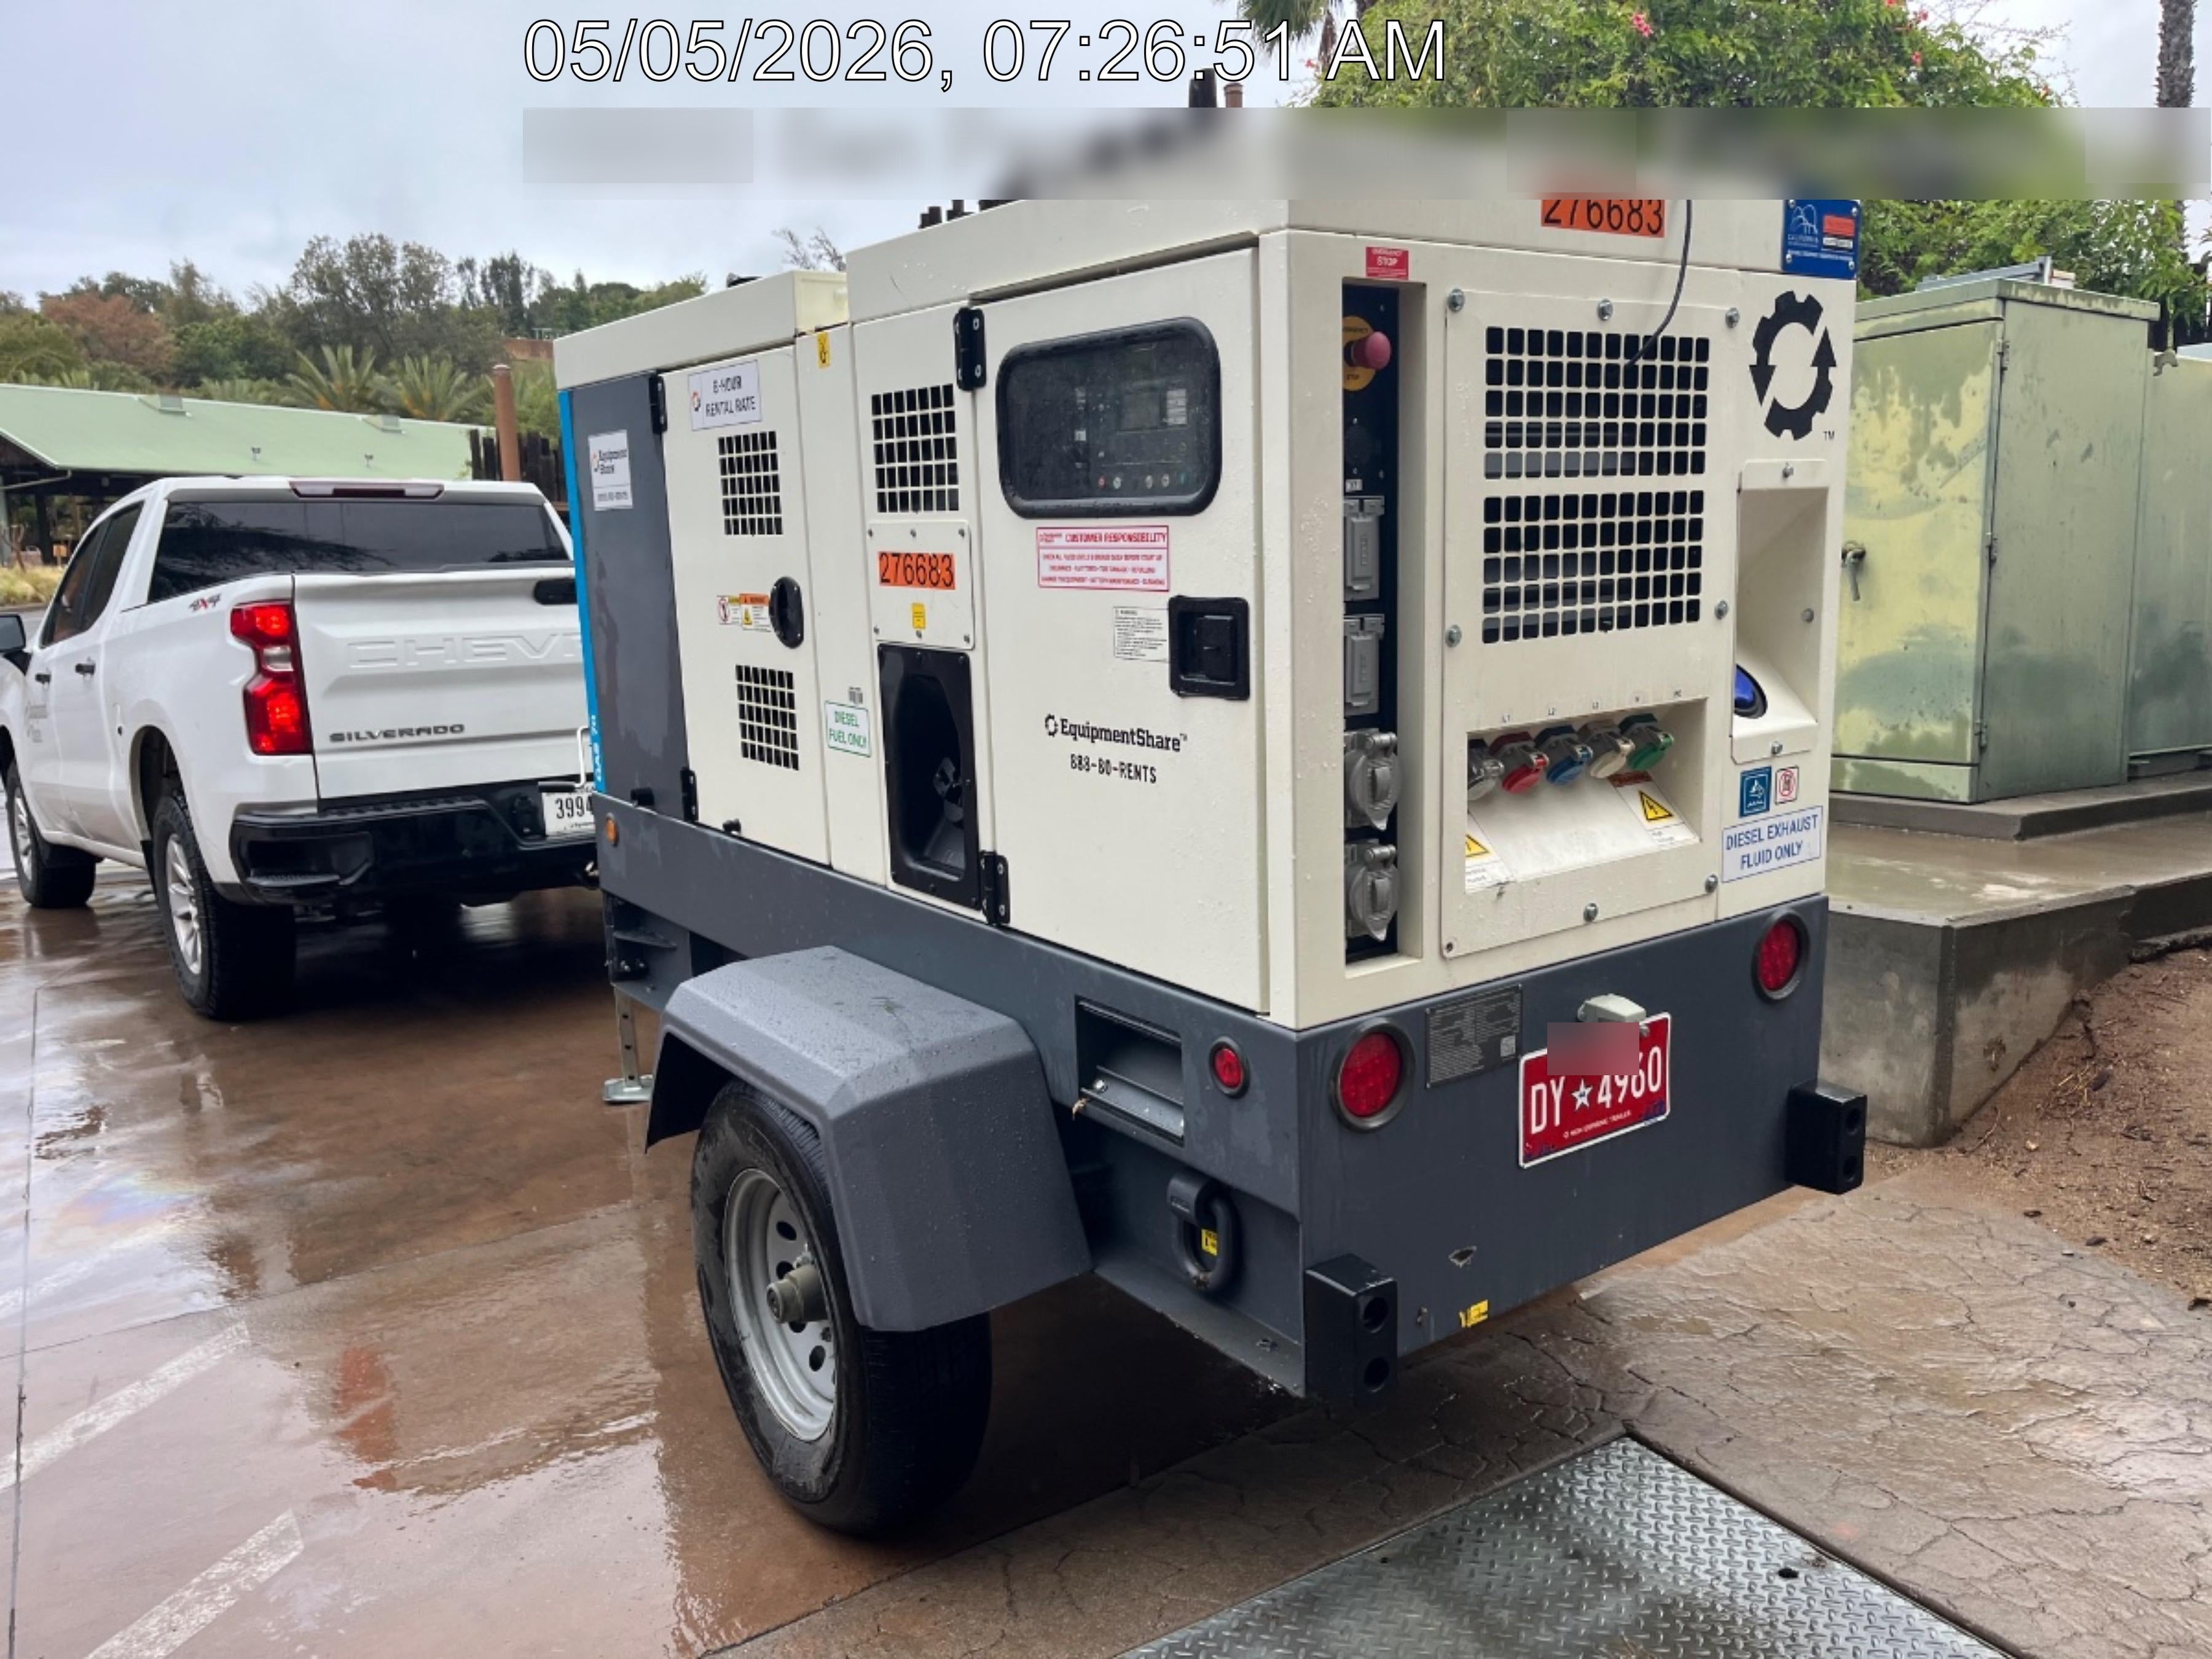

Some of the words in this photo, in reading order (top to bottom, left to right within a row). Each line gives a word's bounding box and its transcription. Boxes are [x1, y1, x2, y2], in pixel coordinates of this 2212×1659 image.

[1544, 199, 1663, 235] 276683
[879, 552, 954, 587] 276683
[329, 724, 465, 743] SILVERADO
[1726, 828, 1765, 850] DIESEL
[1767, 815, 1818, 840] EXHAUST
[1740, 849, 1773, 870] FLUID
[1775, 841, 1803, 860] ONLY
[1531, 1075, 1566, 1135] DY
